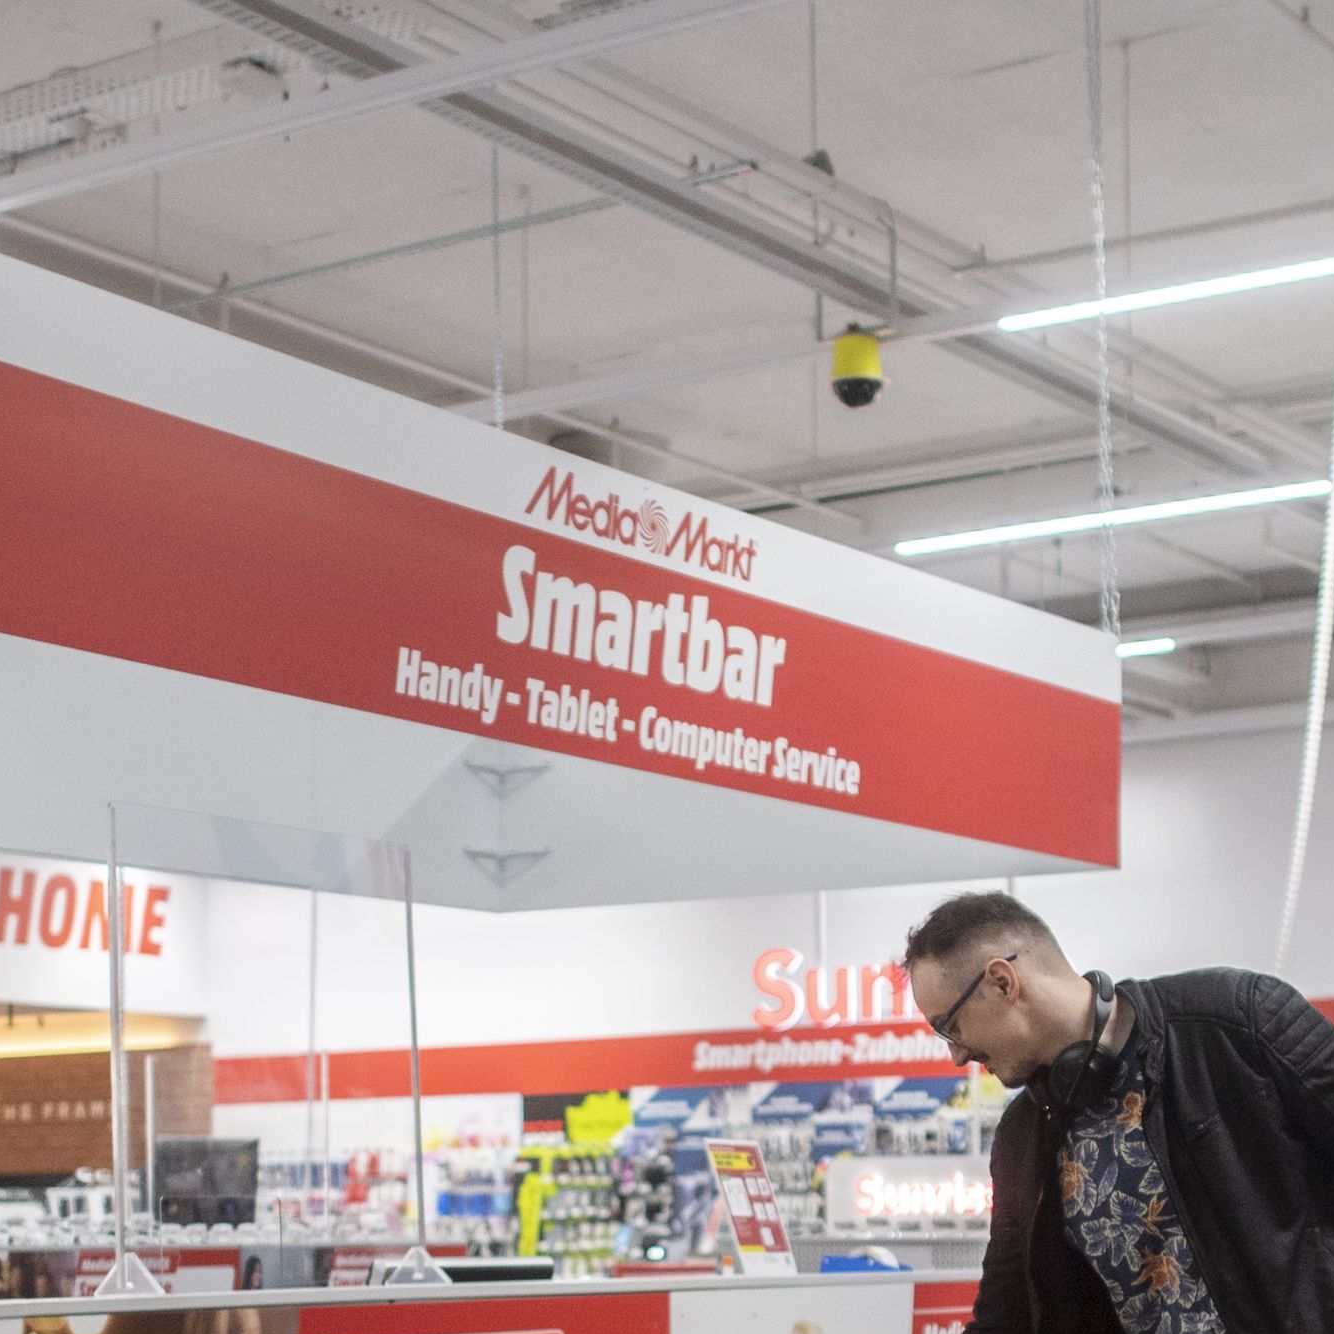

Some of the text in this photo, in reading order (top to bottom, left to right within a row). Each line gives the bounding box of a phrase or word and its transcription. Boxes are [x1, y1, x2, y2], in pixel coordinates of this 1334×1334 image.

[496, 545, 786, 707] Smartbar
[395, 647, 504, 725] Handy
[526, 678, 619, 743] Tablet
[639, 705, 770, 776] Computer
[772, 737, 861, 796] Service
[752, 946, 915, 1032] Sun
[856, 1169, 995, 1216] Sunris
